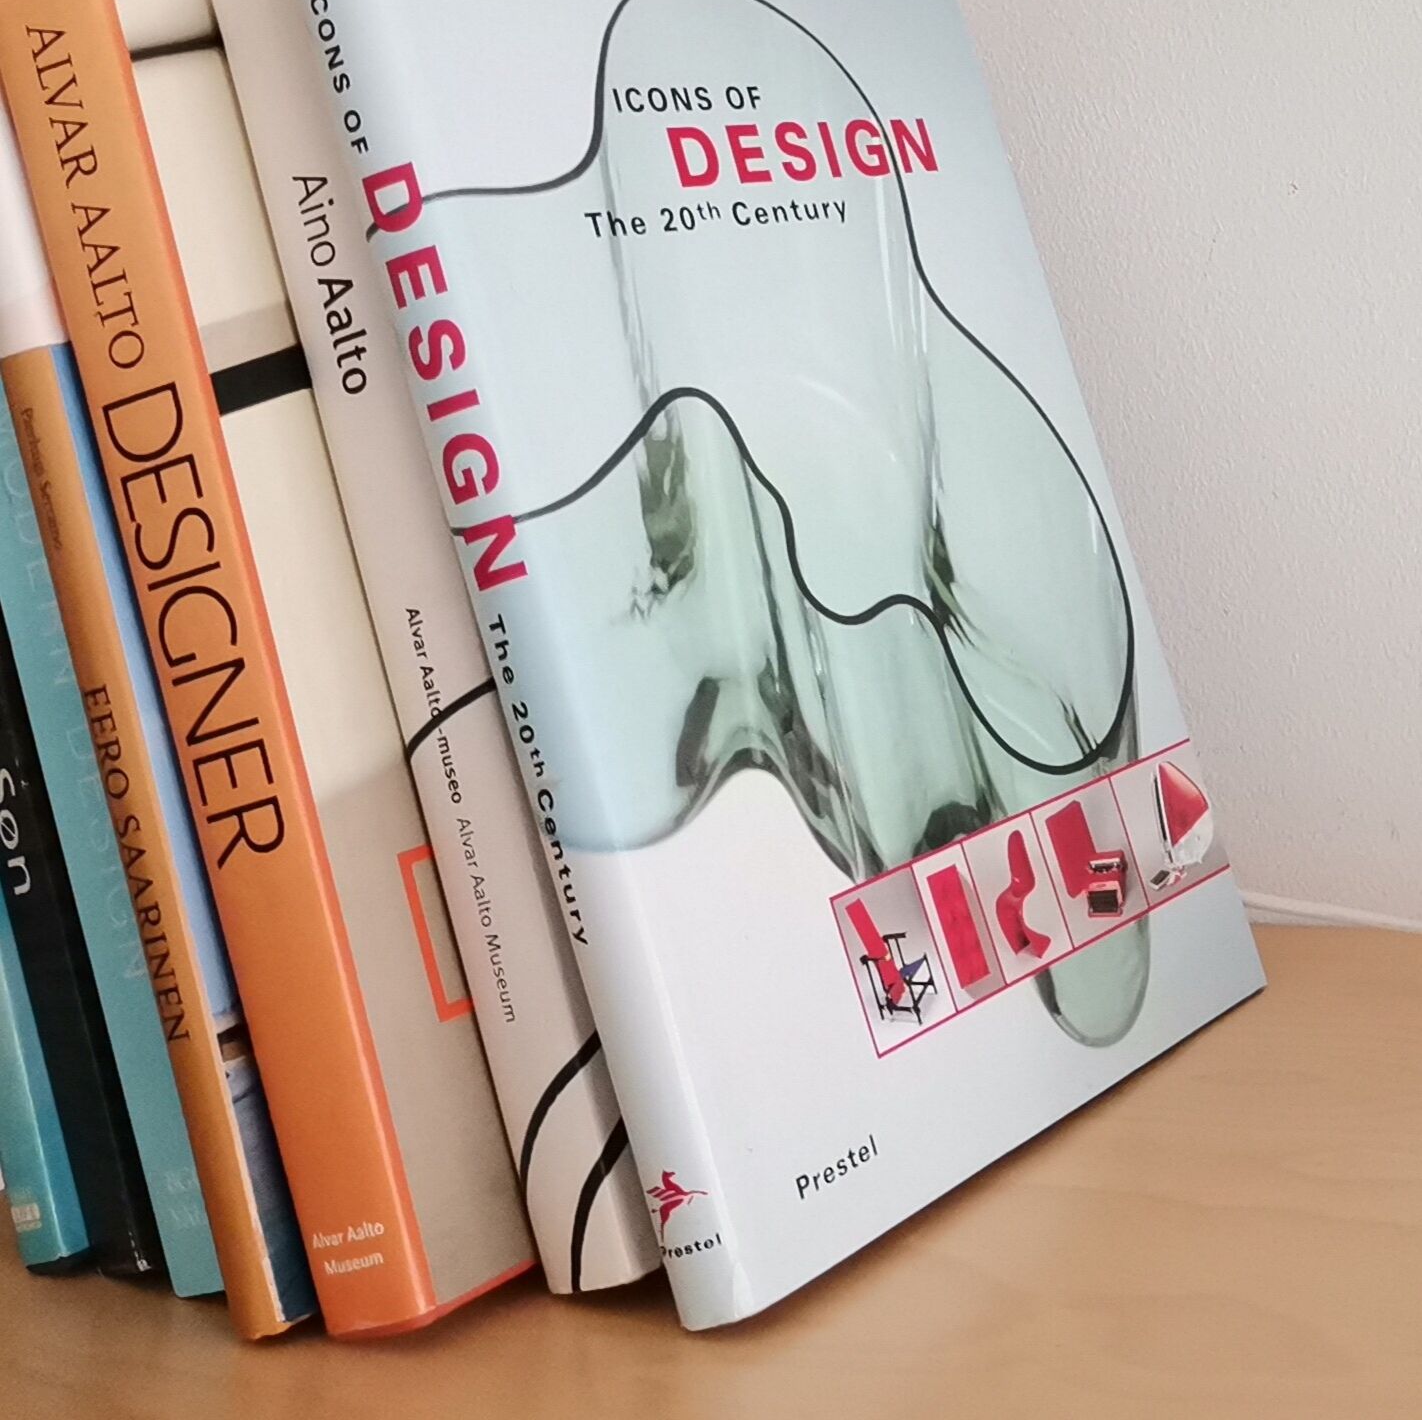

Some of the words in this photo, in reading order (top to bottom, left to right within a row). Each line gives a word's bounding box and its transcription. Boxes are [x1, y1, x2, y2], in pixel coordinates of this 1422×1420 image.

[26, 24, 99, 189] ALVAR
[613, 86, 712, 112] ICONS
[726, 86, 761, 109] OF
[667, 118, 938, 188] DESIGN
[71, 201, 146, 370] AALTO
[291, 174, 335, 268] Aino
[317, 277, 368, 396] Aalto
[584, 212, 646, 238] The
[661, 201, 721, 232] 20th
[731, 200, 847, 226] Century
[343, 110, 370, 155] OF
[361, 161, 527, 591] DESIGN
[489, 613, 515, 686] The
[511, 701, 547, 780] 20th
[536, 788, 589, 947] Century
[101, 382, 286, 871] DESIGNER
[83, 683, 131, 800] EERO
[115, 812, 190, 1044] SAARINEN
[404, 606, 429, 660] Alvar
[455, 816, 479, 871] Alvar
[469, 874, 492, 929] Aalto
[485, 933, 517, 1024] Museum
[312, 1227, 348, 1251] Alvar
[347, 1220, 385, 1246] Aalto
[795, 1134, 878, 1200] Prestel
[324, 1250, 384, 1276] Museum
